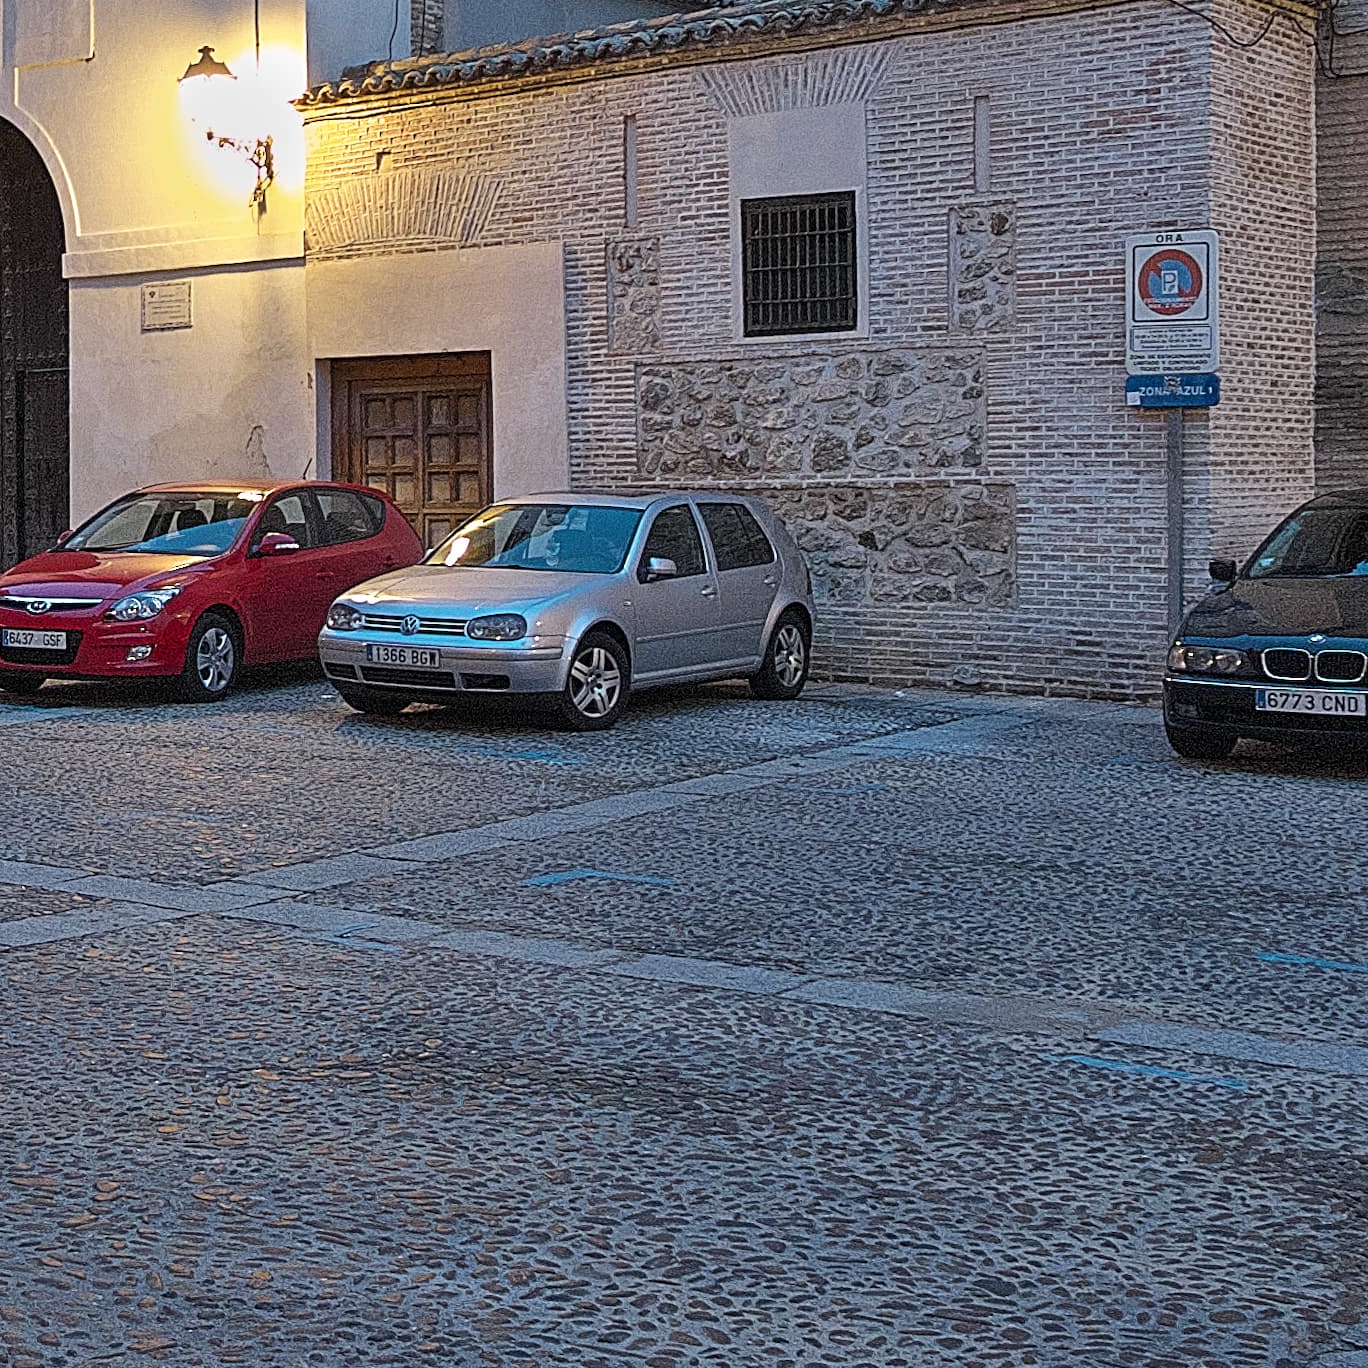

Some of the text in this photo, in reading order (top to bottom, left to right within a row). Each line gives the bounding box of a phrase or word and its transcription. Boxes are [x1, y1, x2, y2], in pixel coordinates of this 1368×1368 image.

[1155, 234, 1184, 243] ORA
[1162, 272, 1177, 291] P
[1138, 386, 1170, 396] ZONA
[1175, 385, 1207, 395] AZUL
[9, 631, 63, 647] 6437 GSF
[376, 646, 437, 665] 1366 BGW
[1267, 692, 1359, 713] 6773 CND
